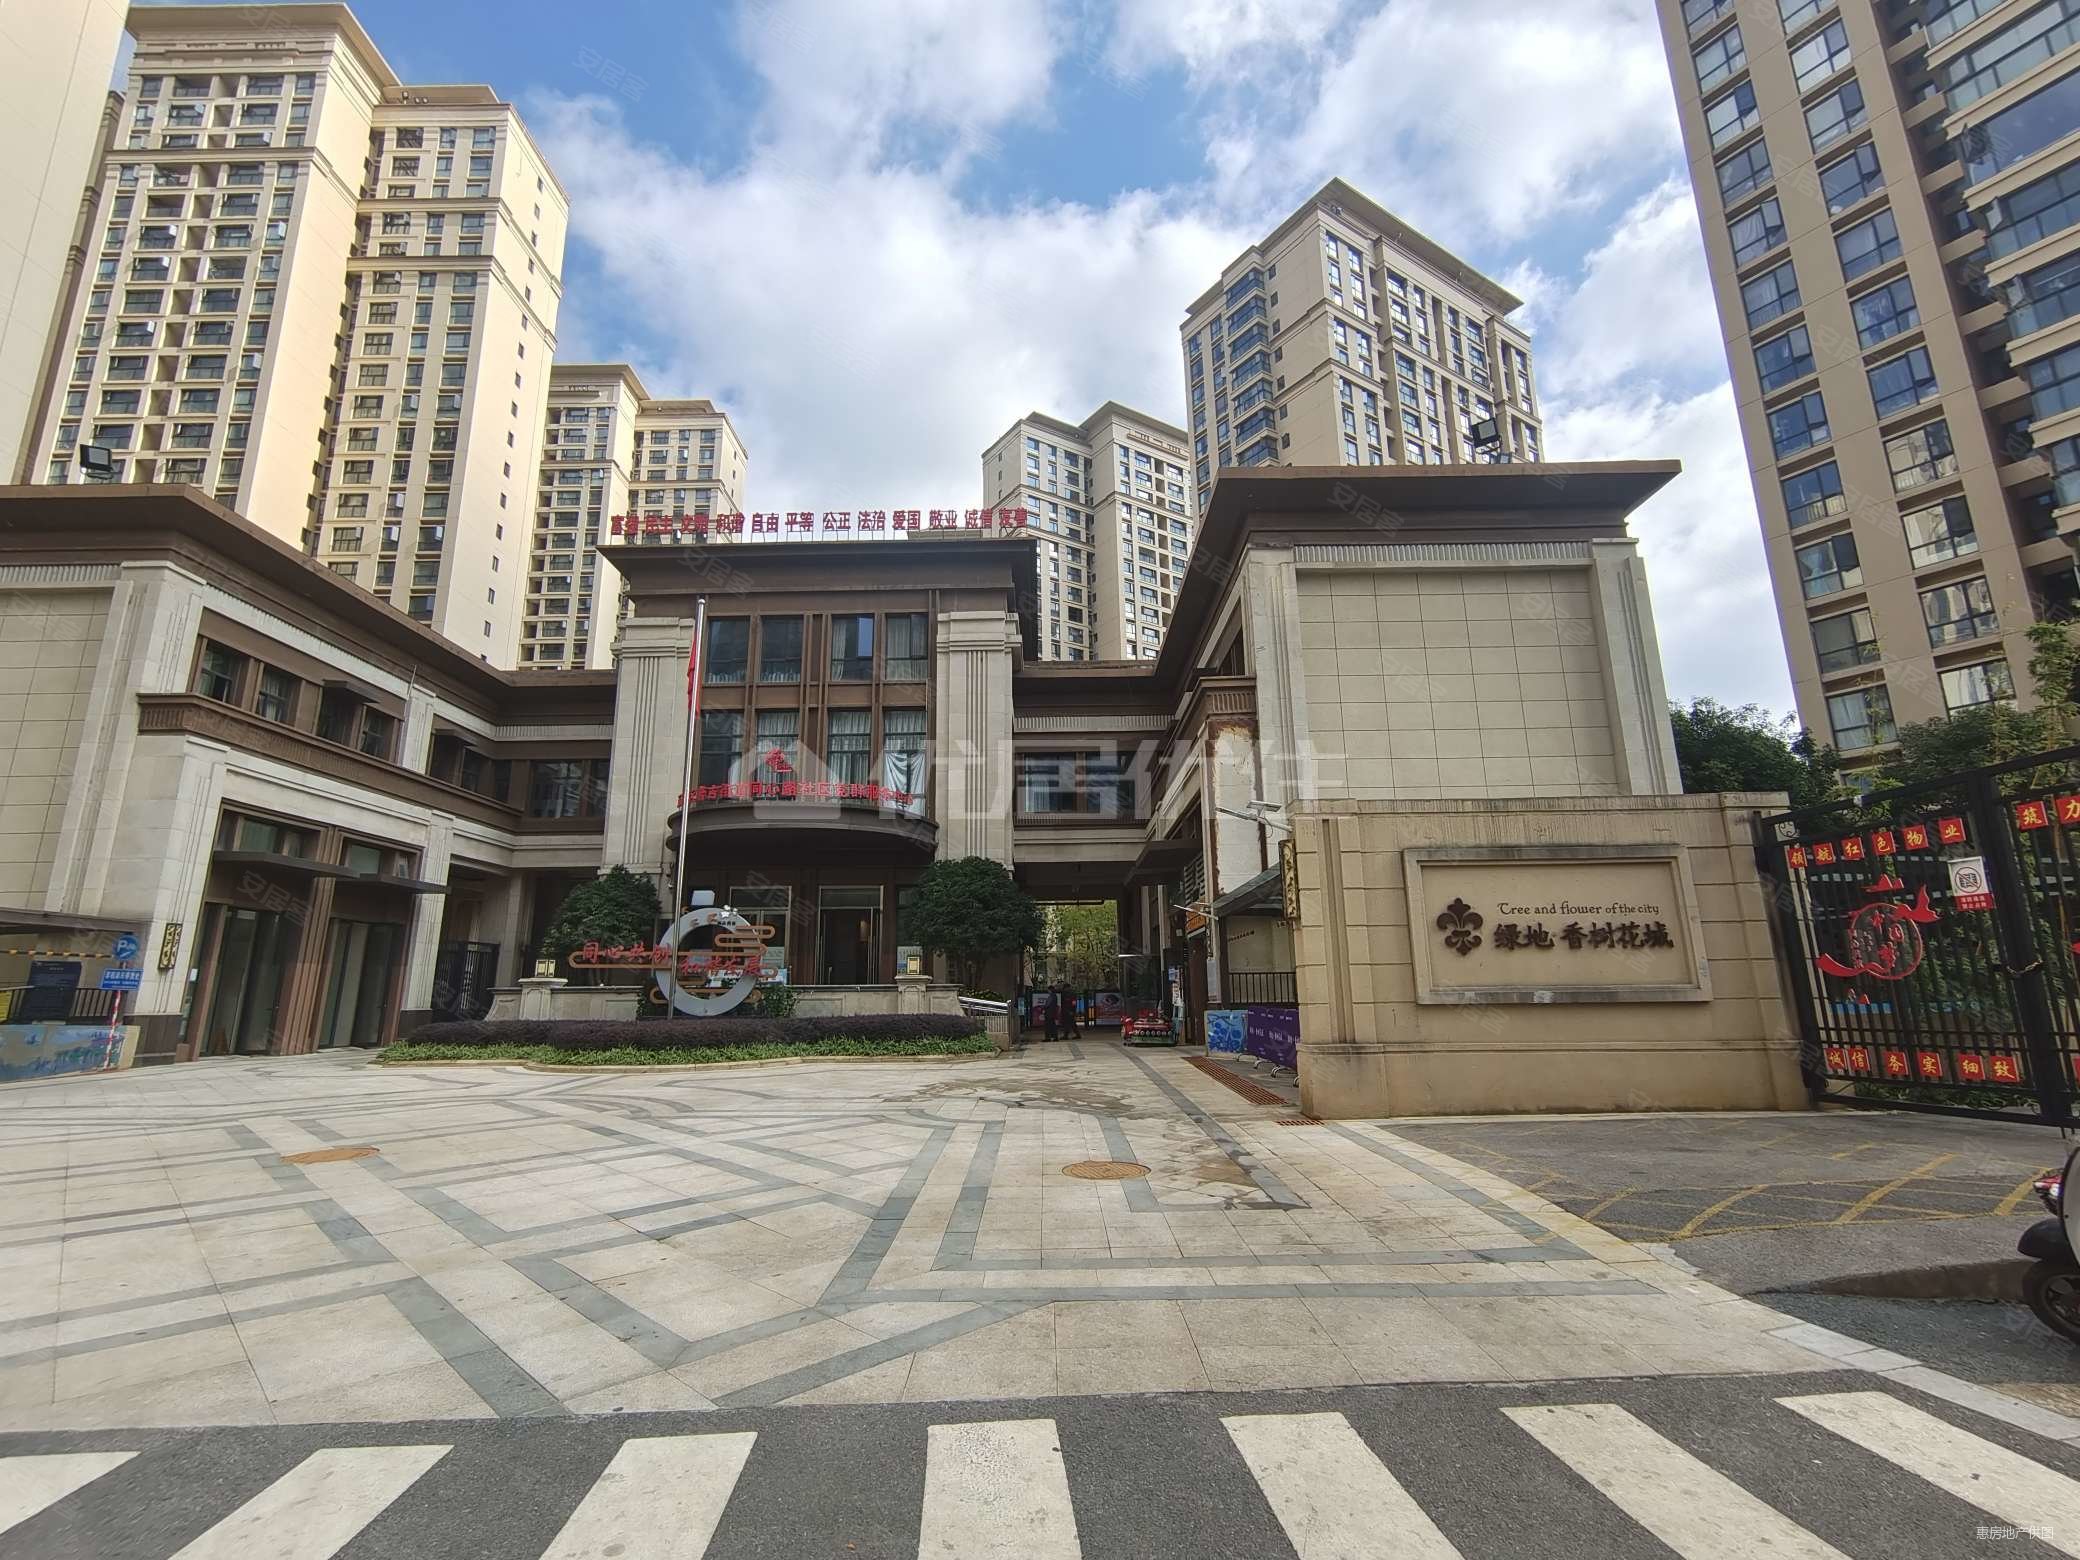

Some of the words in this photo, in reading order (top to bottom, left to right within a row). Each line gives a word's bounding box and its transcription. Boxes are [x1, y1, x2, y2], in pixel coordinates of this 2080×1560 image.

[752, 512, 779, 533] 自由
[785, 512, 814, 532] 平等
[823, 512, 850, 530] 公正
[858, 511, 885, 531] 法治
[892, 510, 920, 529] 爱国
[929, 510, 957, 529] 敬业
[965, 509, 993, 529] 诚信
[1791, 823, 1961, 867] 领航红色物业
[1497, 903, 1530, 915] Tree
[1534, 902, 1556, 915] and
[1560, 901, 1602, 915] flower
[1638, 904, 1659, 915] city
[1828, 1047, 2016, 1079] 诚信务实细致
